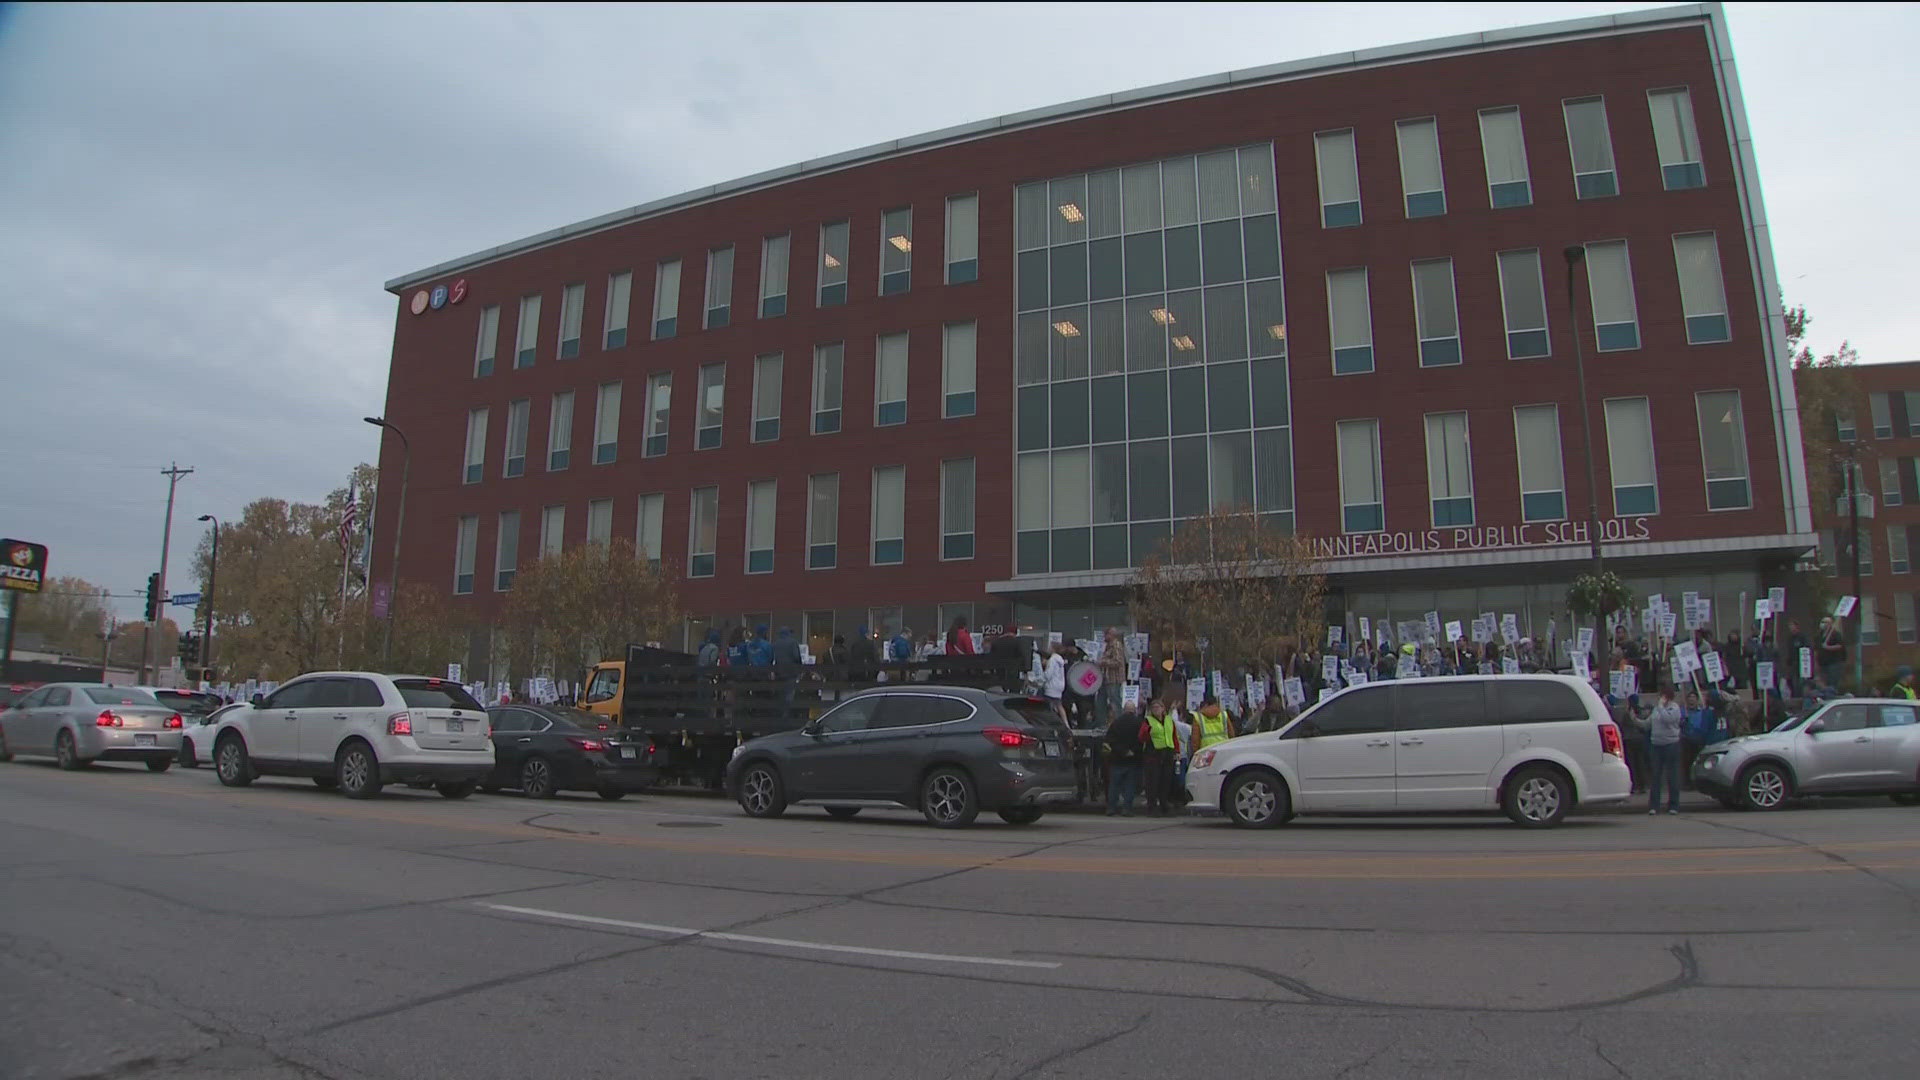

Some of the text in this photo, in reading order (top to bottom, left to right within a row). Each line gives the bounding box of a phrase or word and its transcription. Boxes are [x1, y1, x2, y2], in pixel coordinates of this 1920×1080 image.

[1454, 525, 1531, 548] PUBLIC
[0, 565, 39, 581] PIZZA
[981, 625, 1003, 634] 1250
